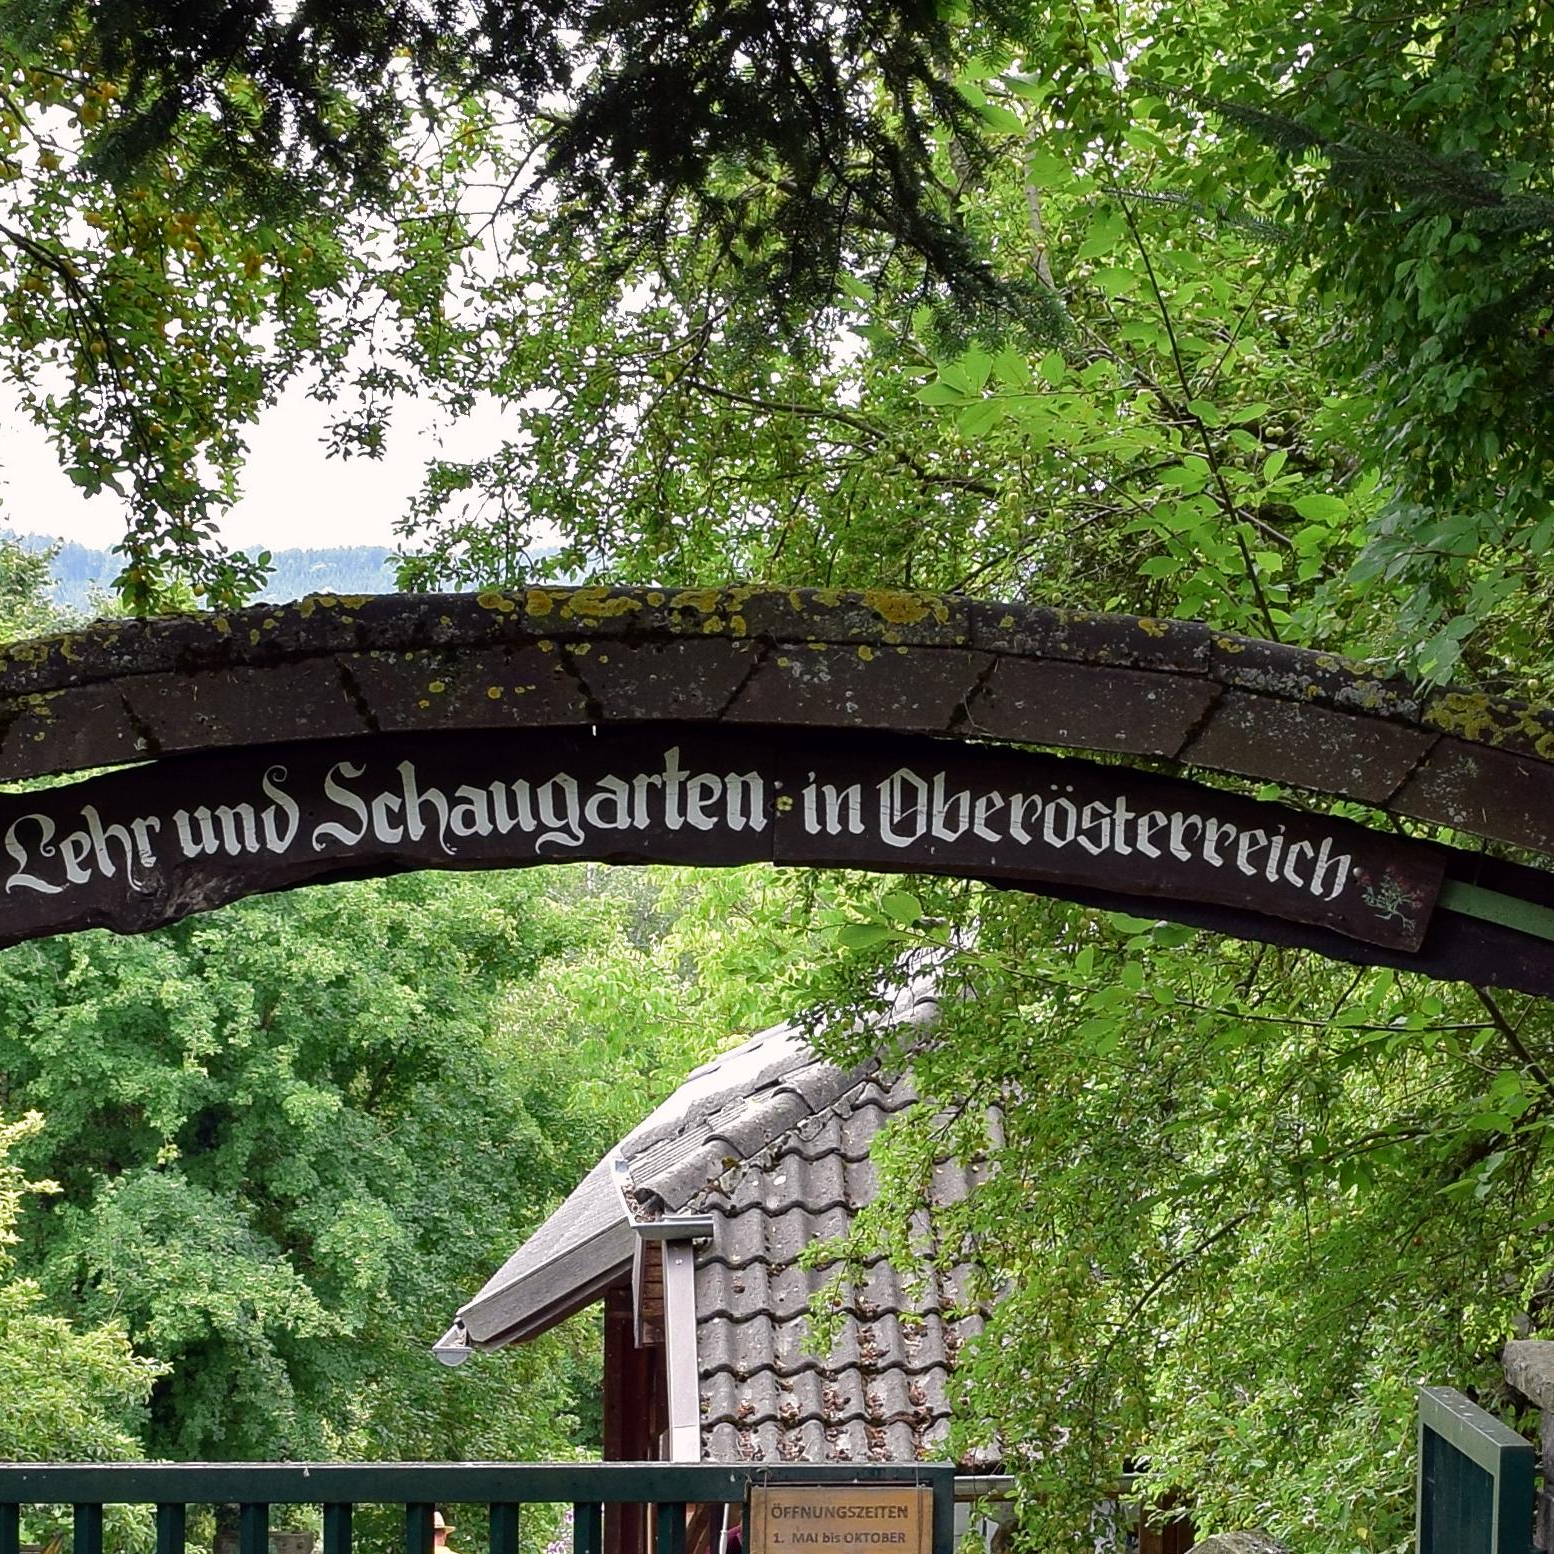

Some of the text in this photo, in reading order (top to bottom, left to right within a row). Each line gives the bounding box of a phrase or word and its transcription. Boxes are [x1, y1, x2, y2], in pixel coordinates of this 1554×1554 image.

[5, 805, 160, 893] Lehr
[173, 765, 300, 858] und
[312, 746, 767, 855] Schaugarten
[802, 771, 865, 834] in
[876, 767, 1352, 900] Oberösterreich
[771, 1503, 908, 1519] ÖFFNUNGSZEITEN
[773, 1532, 906, 1544] 1. MAI bis OKTOBER
